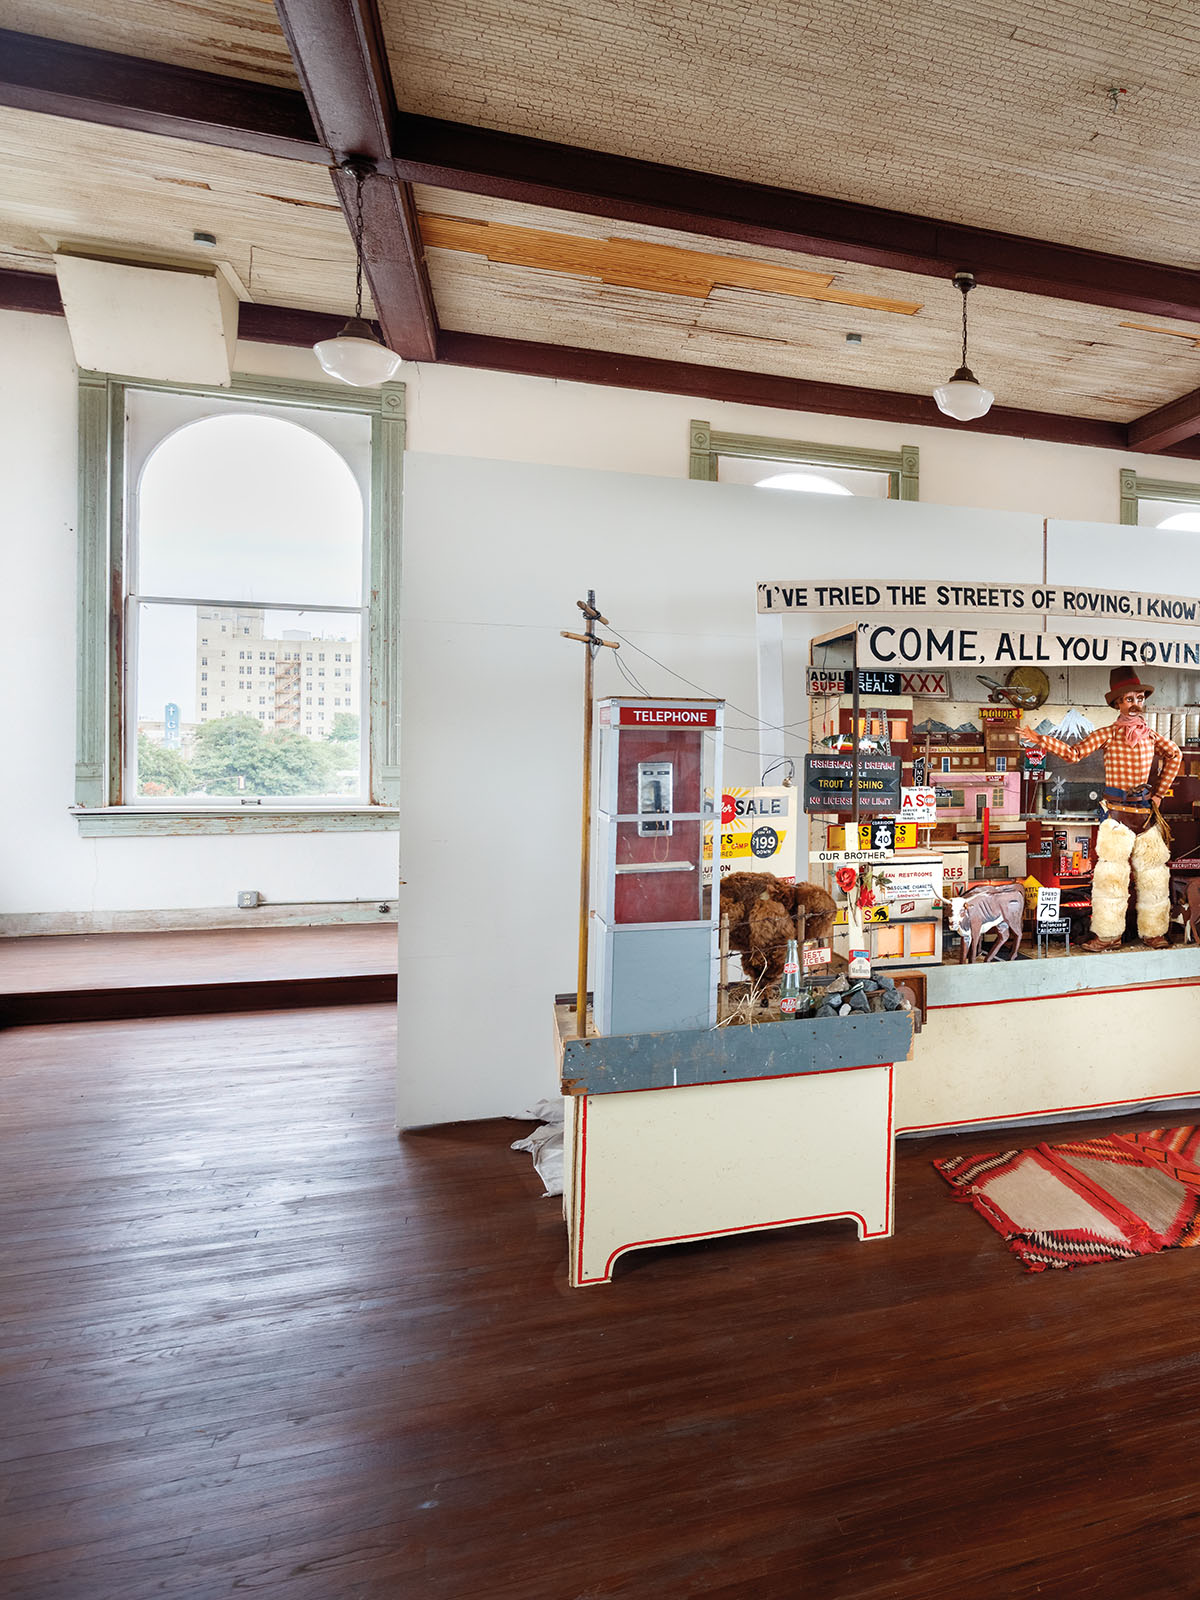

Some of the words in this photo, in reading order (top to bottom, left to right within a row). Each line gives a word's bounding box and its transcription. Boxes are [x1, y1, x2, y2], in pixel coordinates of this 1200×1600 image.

[814, 586, 880, 606] TRIED
[886, 586, 926, 606] THE
[937, 586, 1024, 608] STREETS
[1032, 589, 1056, 608] OF
[1064, 592, 1134, 617] ROVING,
[1137, 597, 1142, 615] I
[995, 633, 1050, 660] ALL
[1056, 636, 1108, 661] YOU
[810, 671, 844, 681] ADUL
[901, 673, 945, 692] XXX
[858, 673, 880, 682] ELL
[884, 674, 894, 683] IS
[812, 682, 844, 691] SUPE
[633, 711, 707, 722] TELEPHONE
[980, 710, 1013, 719] LIQUOR
[810, 760, 862, 769] FISHERMANS
[819, 780, 844, 788] TROUT
[850, 780, 883, 789] FSHING
[735, 799, 781, 815] SALE
[752, 837, 776, 849] $199
[878, 835, 889, 843] 40
[944, 868, 962, 876] RES
[1040, 904, 1057, 917] 75
